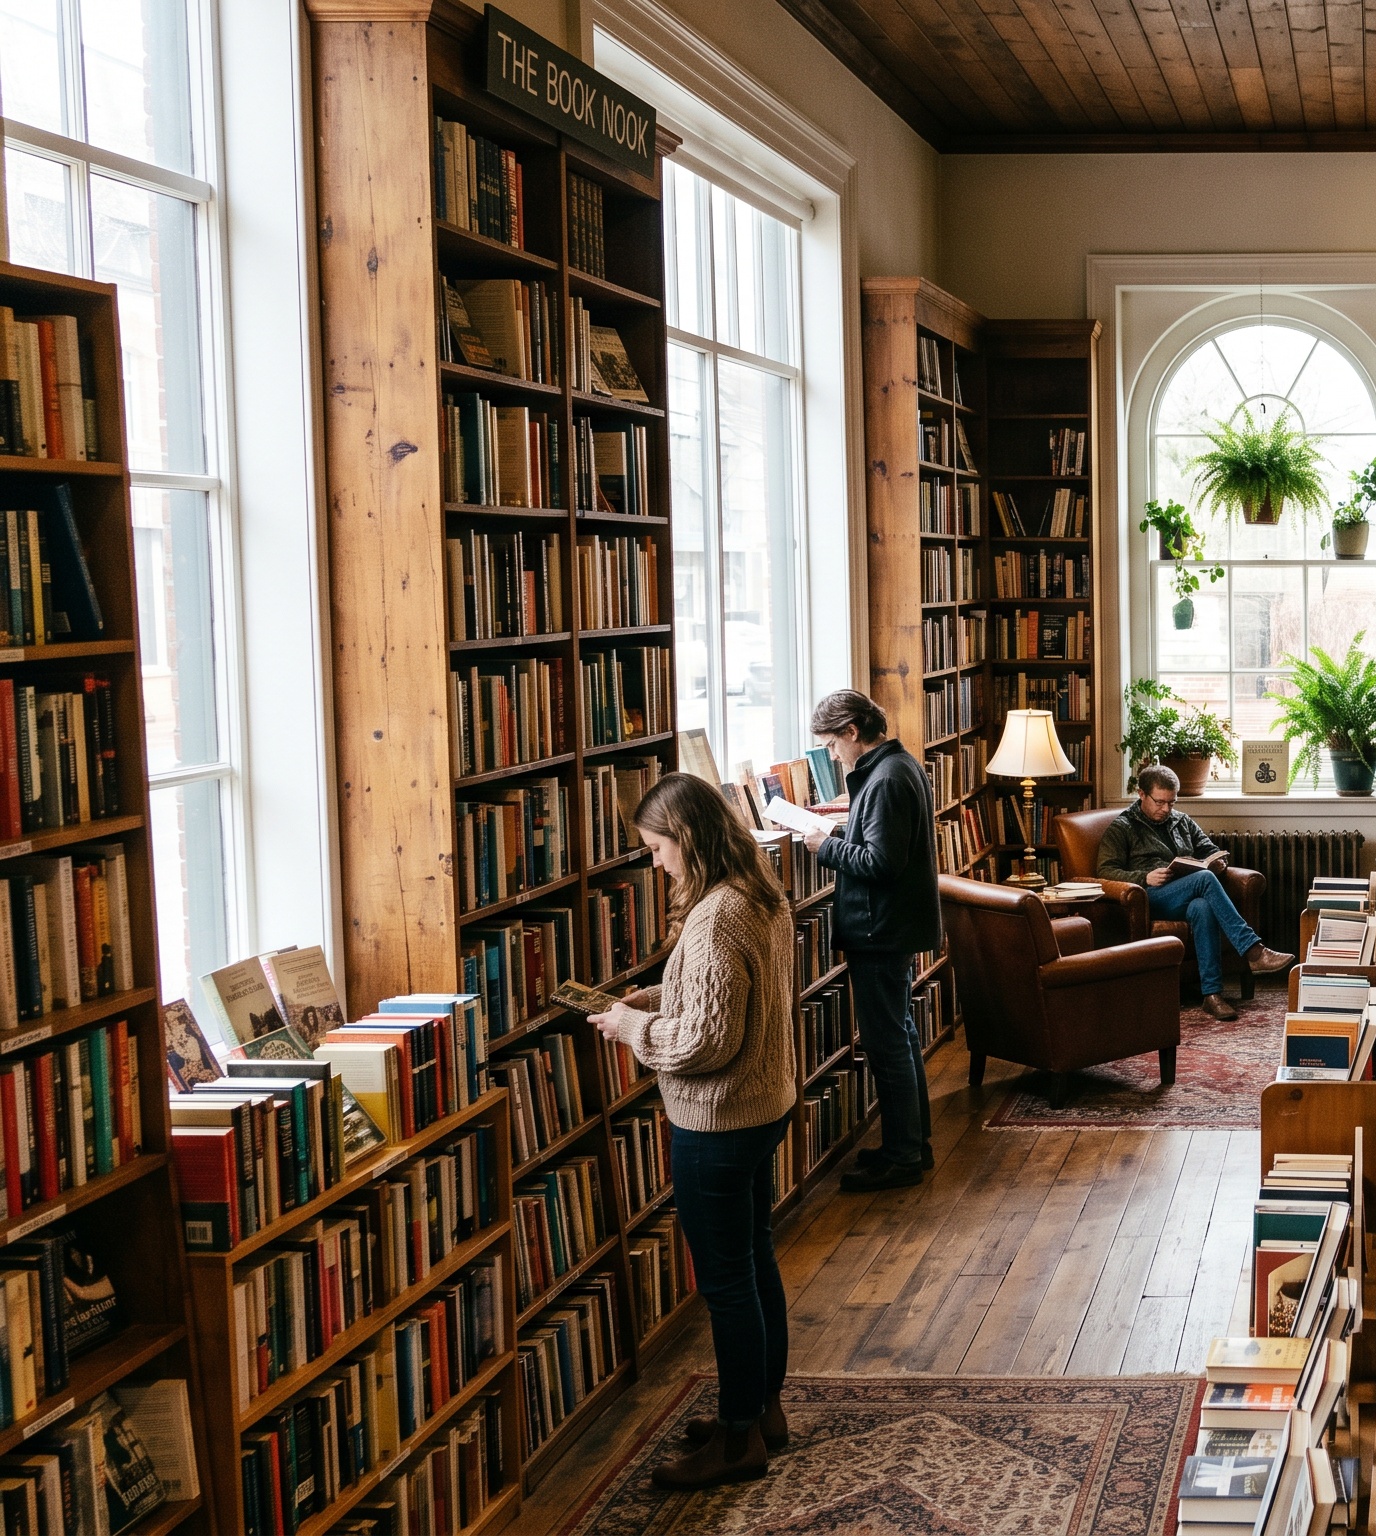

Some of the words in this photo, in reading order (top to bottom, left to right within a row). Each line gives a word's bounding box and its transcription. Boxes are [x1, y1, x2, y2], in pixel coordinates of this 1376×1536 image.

[497, 31, 539, 97] THE
[547, 60, 597, 129] BOOK
[602, 95, 649, 159] NOOK
